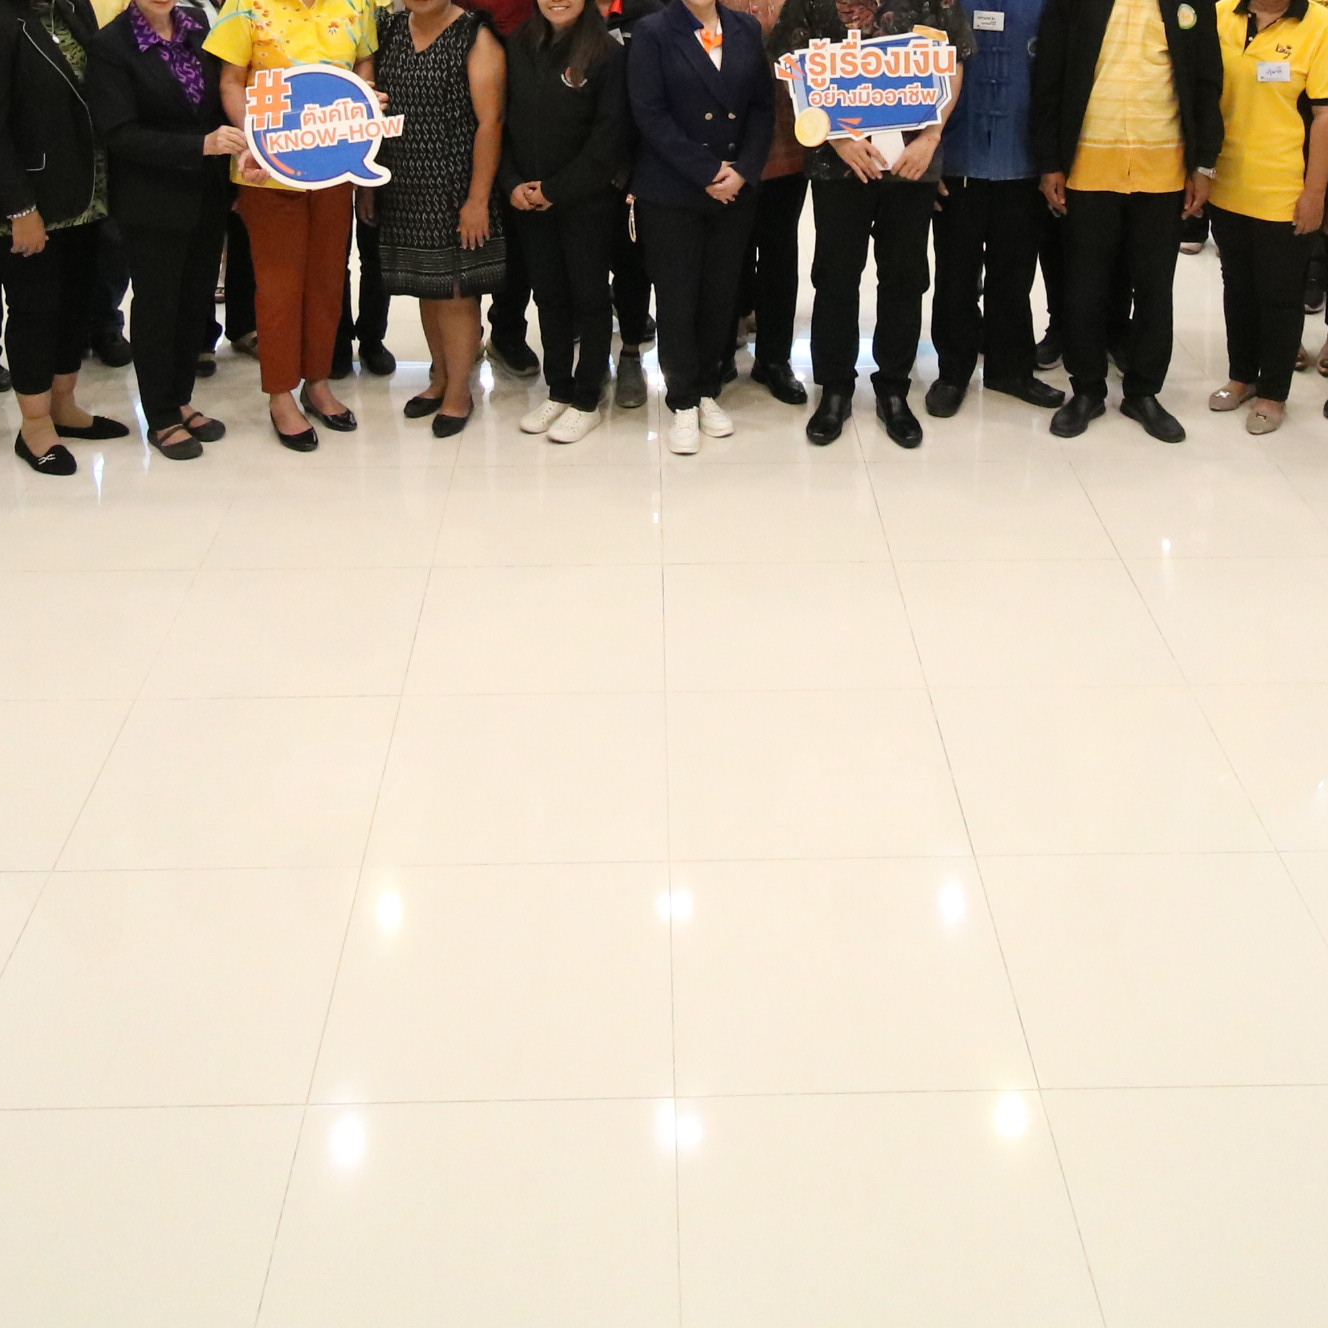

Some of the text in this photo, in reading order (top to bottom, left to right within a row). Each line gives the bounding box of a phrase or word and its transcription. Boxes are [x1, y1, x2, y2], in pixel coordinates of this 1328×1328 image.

[808, 32, 956, 87] รู้เรื่องเงิน
[810, 85, 937, 106] อย่างมืออาชีพ
[302, 101, 365, 126] ตังค์โต
[269, 119, 402, 151] KNOW-HOW
